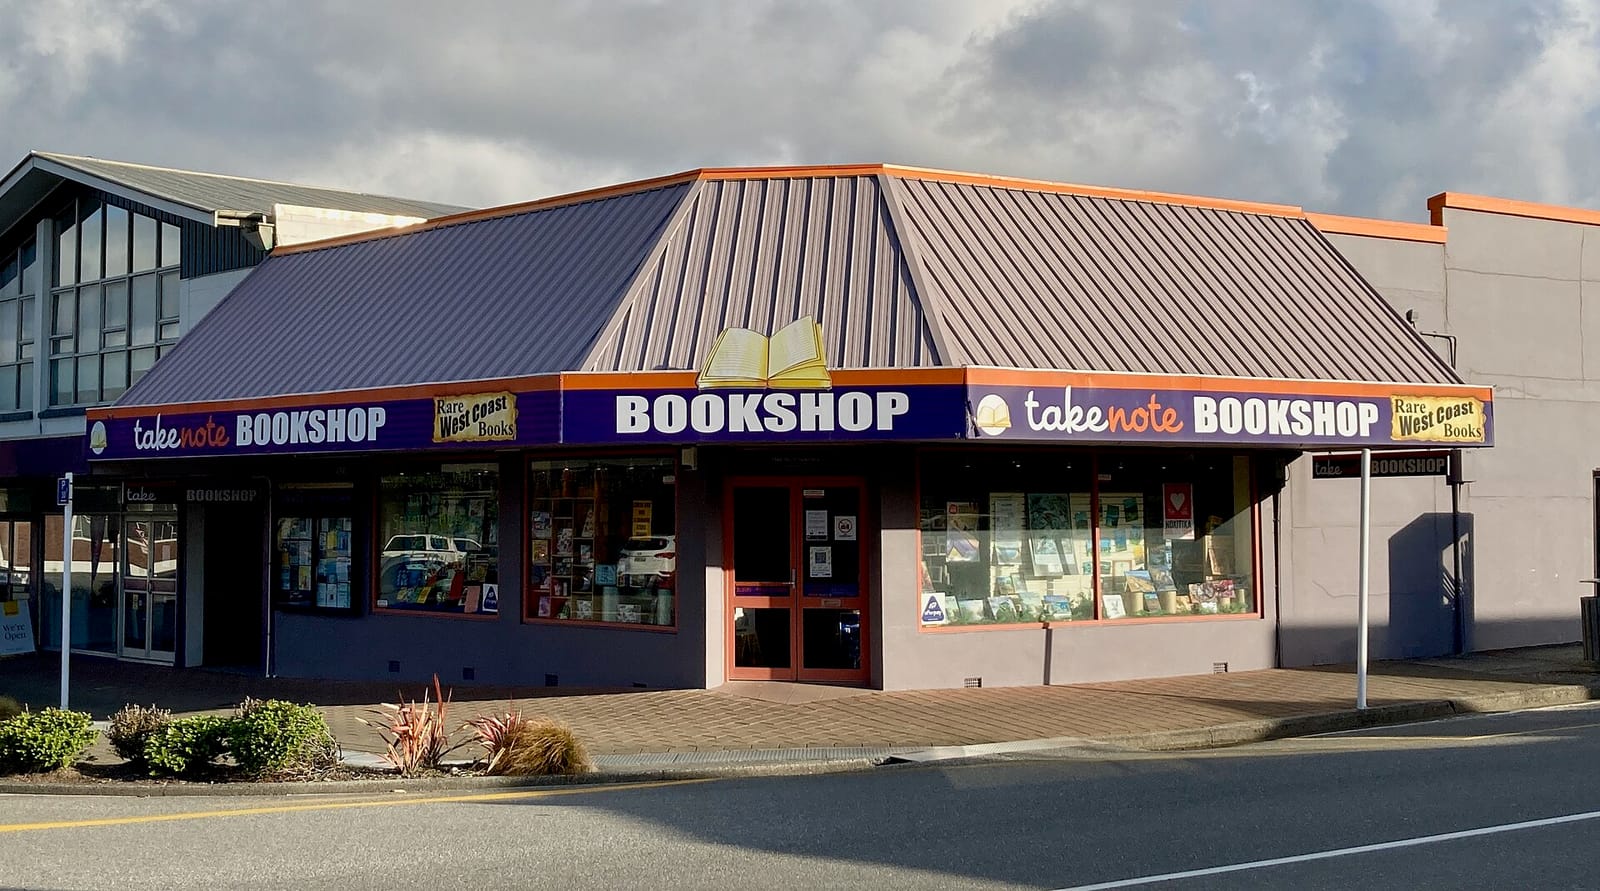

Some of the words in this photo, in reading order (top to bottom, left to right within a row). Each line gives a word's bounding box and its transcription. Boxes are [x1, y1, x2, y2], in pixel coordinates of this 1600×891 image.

[437, 399, 464, 414] Rare
[616, 391, 909, 433] BOOKSHOP
[1394, 398, 1426, 414] Rare
[440, 408, 470, 438] West
[472, 395, 508, 424] Coast
[1193, 396, 1379, 437] BOOKSHOP
[1399, 411, 1434, 437] West
[1436, 401, 1474, 424] Coast
[236, 407, 386, 447] BOOKSHOP
[478, 420, 514, 437] Books
[1444, 423, 1482, 439] Books
[1315, 459, 1343, 476] take
[1371, 458, 1445, 474] BOOKSHOP
[126, 486, 157, 502] take
[186, 488, 257, 502] BOOKSHOP
[4, 632, 26, 640] Open
